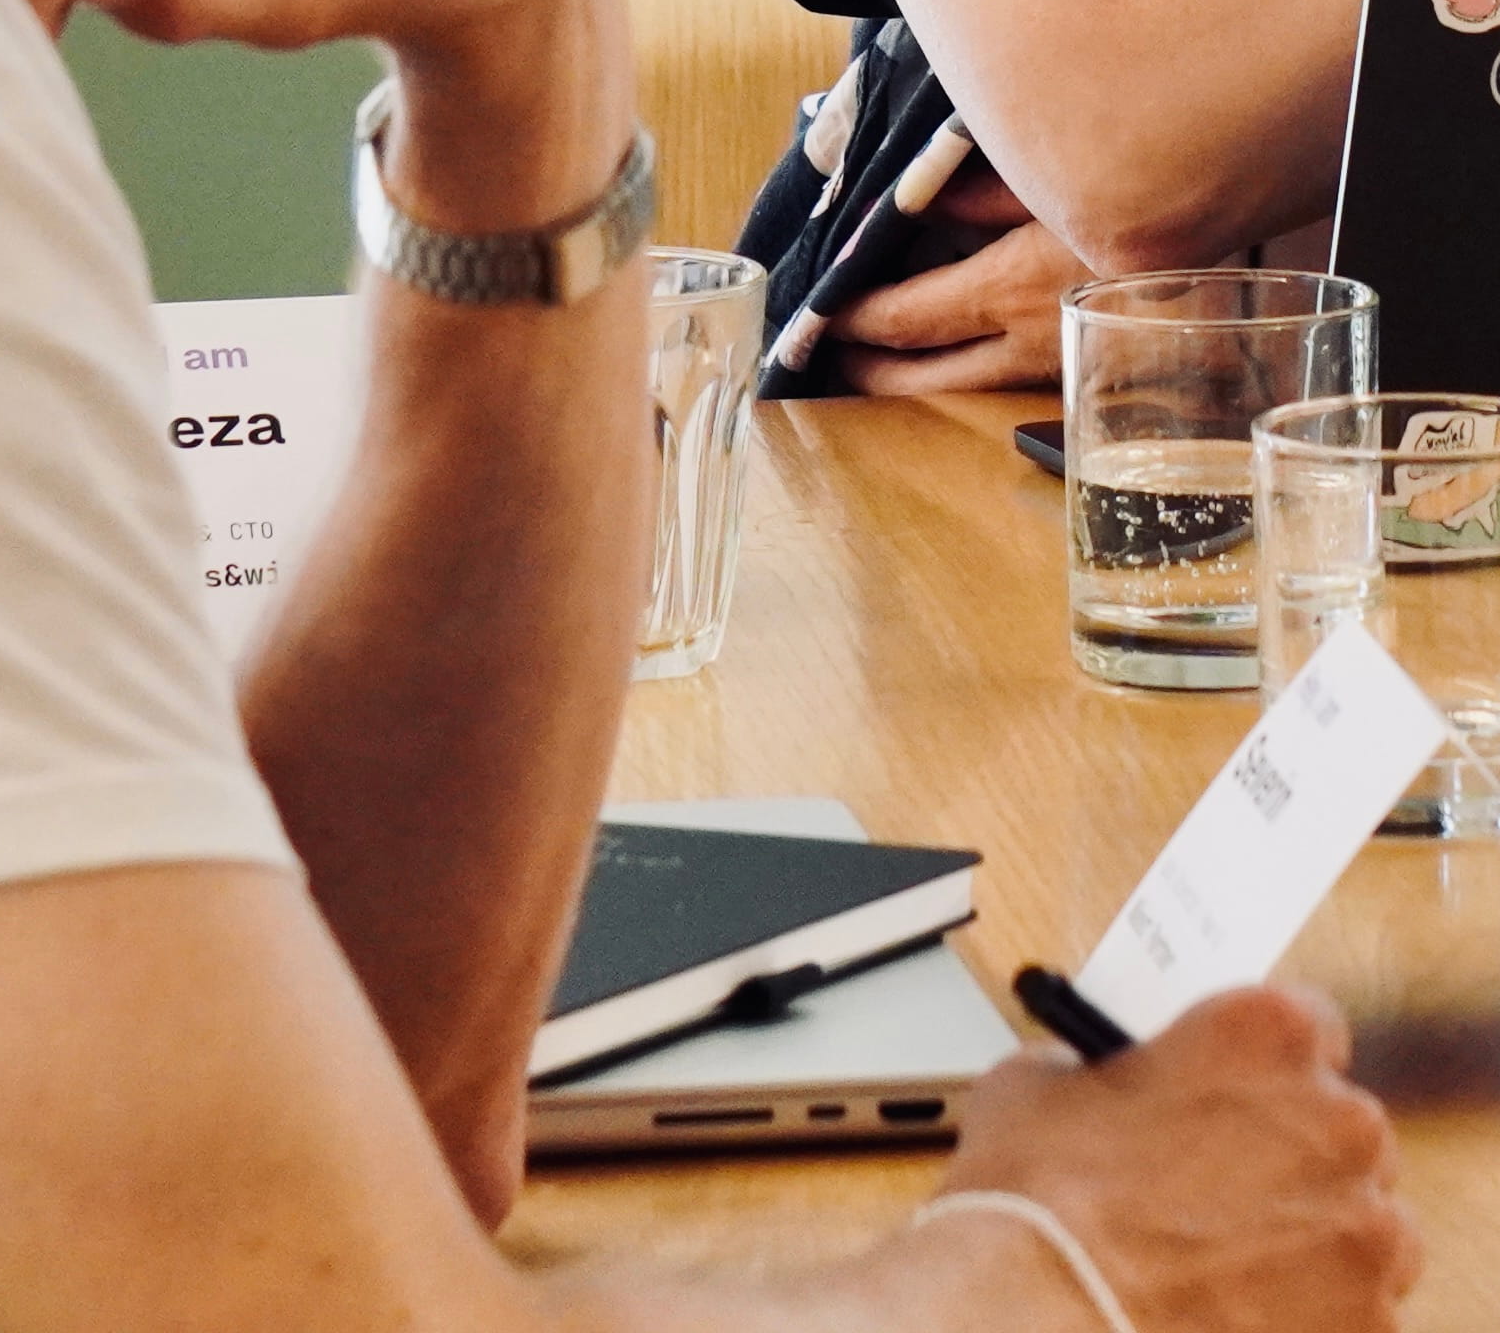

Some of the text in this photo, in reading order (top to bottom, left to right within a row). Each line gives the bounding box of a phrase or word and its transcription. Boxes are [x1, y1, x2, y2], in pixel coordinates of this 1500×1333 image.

[183, 346, 248, 370] am
[167, 413, 286, 449] eza
[230, 521, 274, 541] CTO
